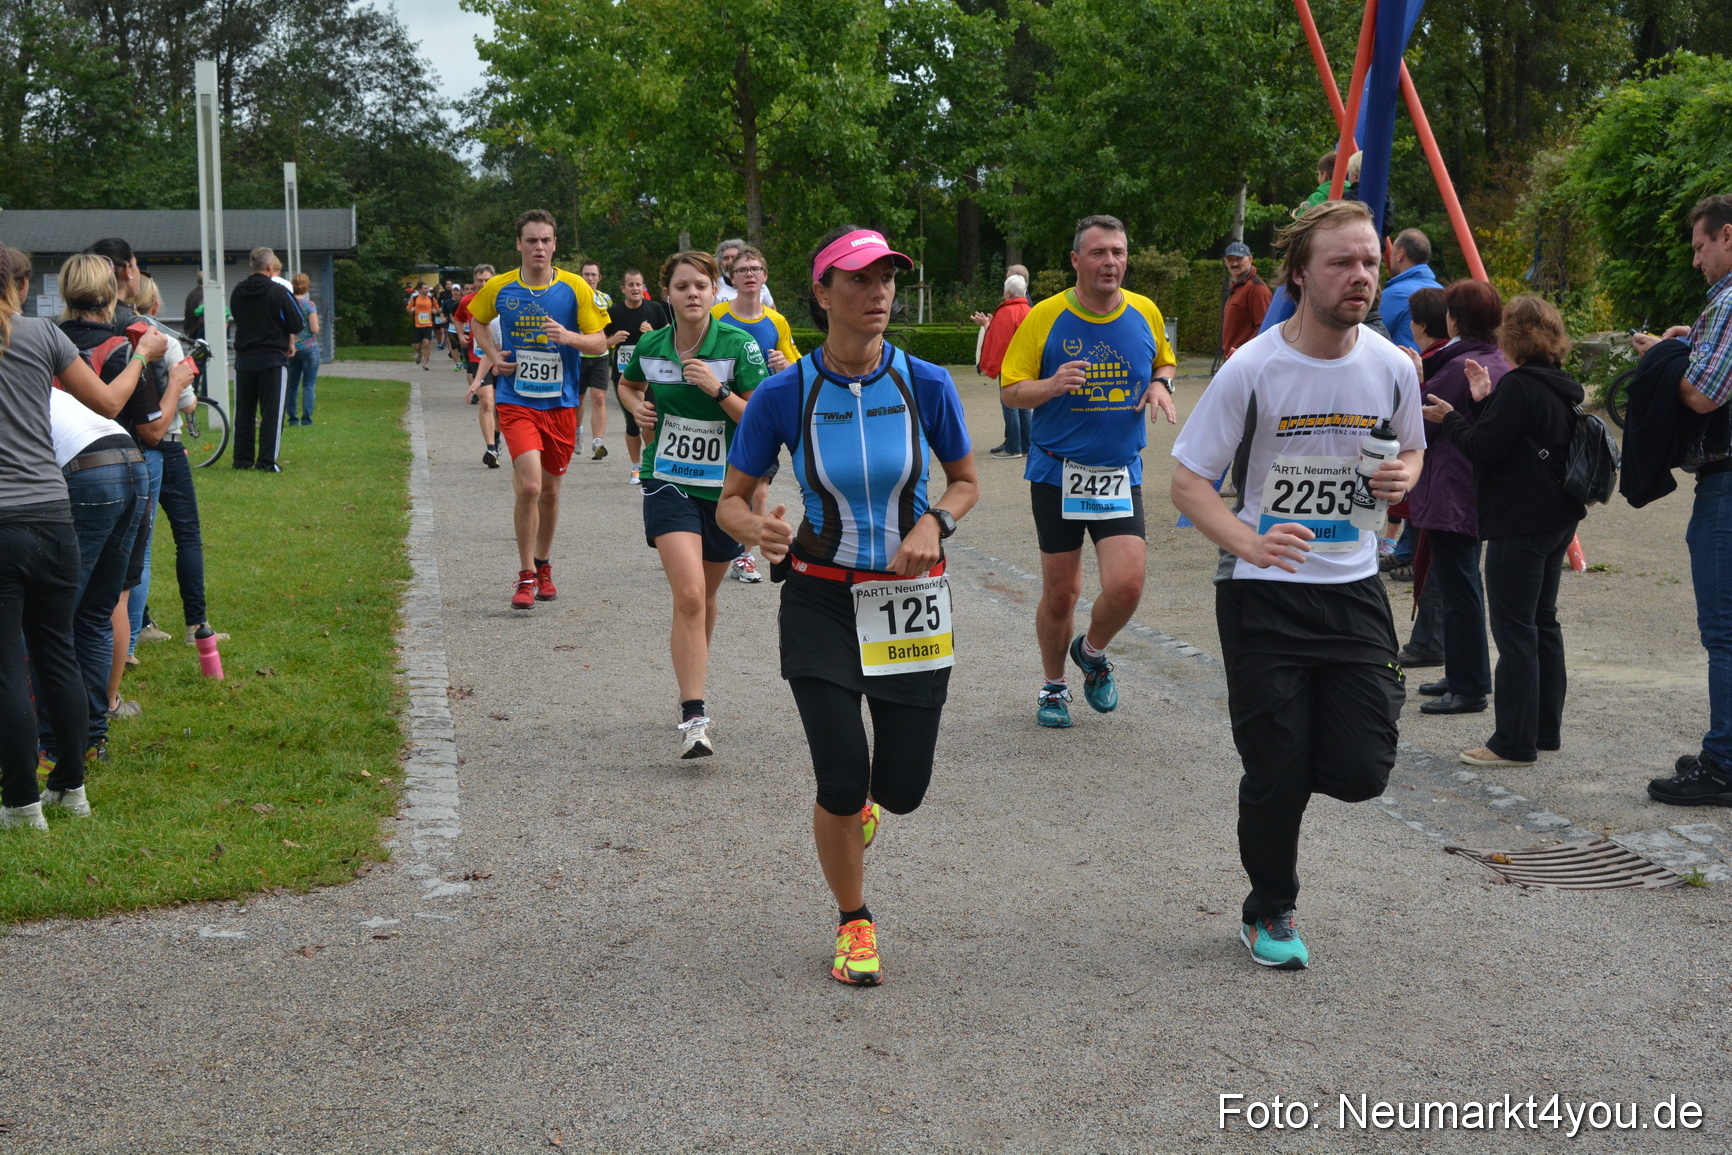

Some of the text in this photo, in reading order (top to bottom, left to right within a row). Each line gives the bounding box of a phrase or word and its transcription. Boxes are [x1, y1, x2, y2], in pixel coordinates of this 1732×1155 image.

[620, 352, 632, 363] 33
[520, 361, 558, 381] 2591
[522, 382, 554, 391] Sebastian
[664, 420, 716, 435] PARTL Neumarkt
[663, 431, 720, 462] 2690
[671, 464, 704, 477] Andrea
[1271, 462, 1352, 476] PARTL Neumarkt
[1070, 472, 1124, 496] 2427
[1271, 479, 1357, 515] 2253
[1080, 500, 1115, 511] Thomas
[1311, 525, 1336, 539] uel
[857, 580, 939, 599] PARTL Neumarkt
[879, 594, 940, 635] 125
[888, 643, 940, 660] Barbara
